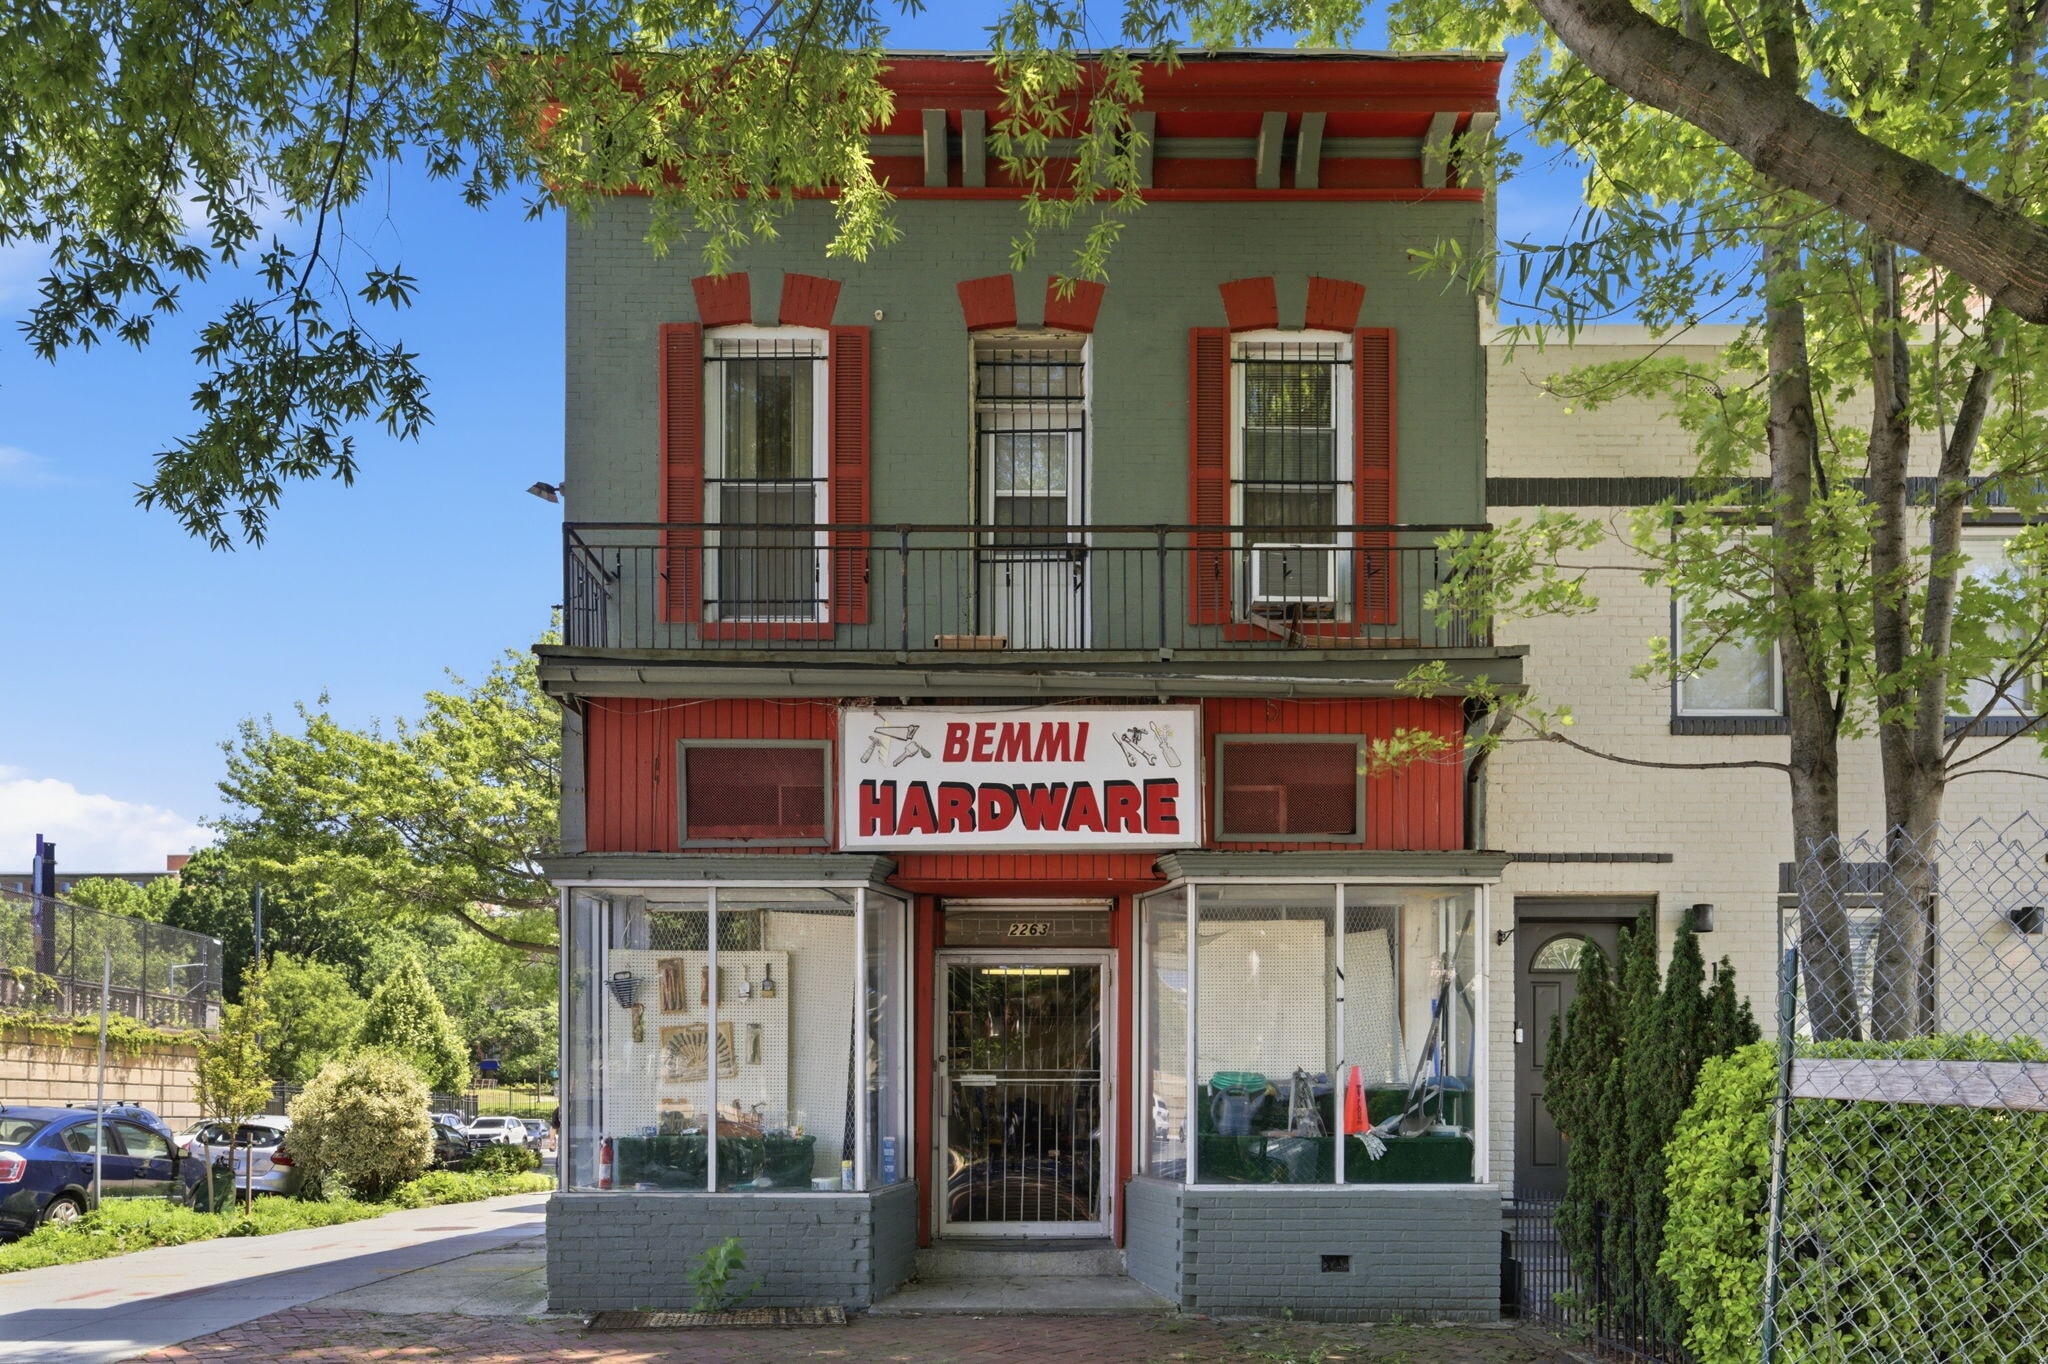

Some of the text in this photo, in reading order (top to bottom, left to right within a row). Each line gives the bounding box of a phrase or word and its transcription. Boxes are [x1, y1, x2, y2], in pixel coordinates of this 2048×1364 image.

[942, 721, 1090, 763] BEMMI
[859, 778, 1180, 837] HARDWARE
[1009, 923, 1048, 936] 2263
